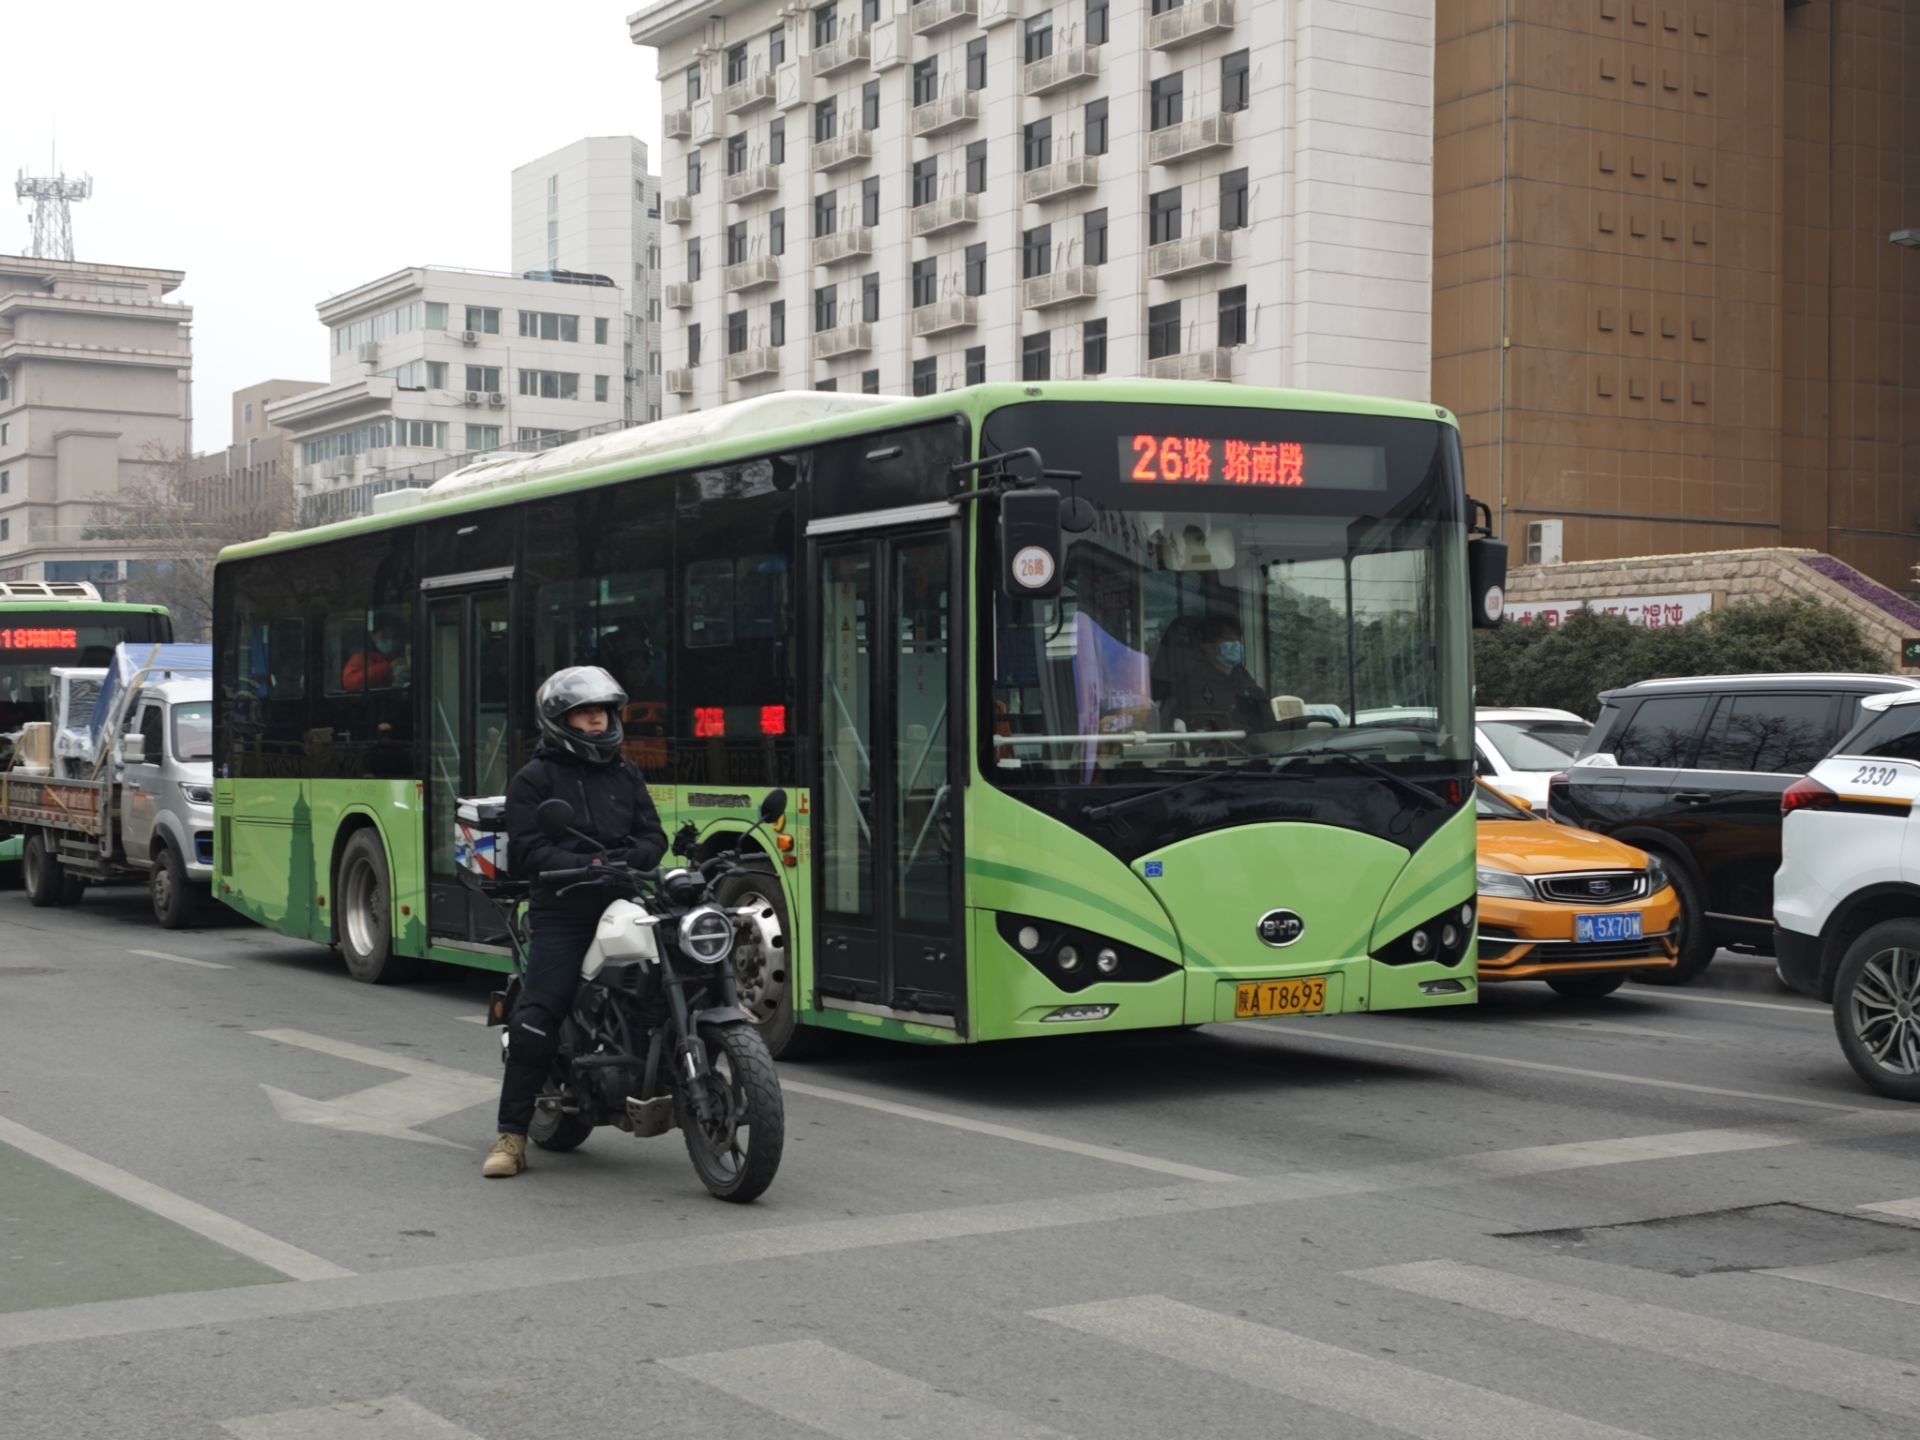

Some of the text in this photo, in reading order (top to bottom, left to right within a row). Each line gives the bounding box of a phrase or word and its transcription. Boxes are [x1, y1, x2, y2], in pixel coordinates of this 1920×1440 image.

[1132, 435, 1211, 482] 26路
[1851, 766, 1898, 786] 2330
[1263, 919, 1299, 936] BYD
